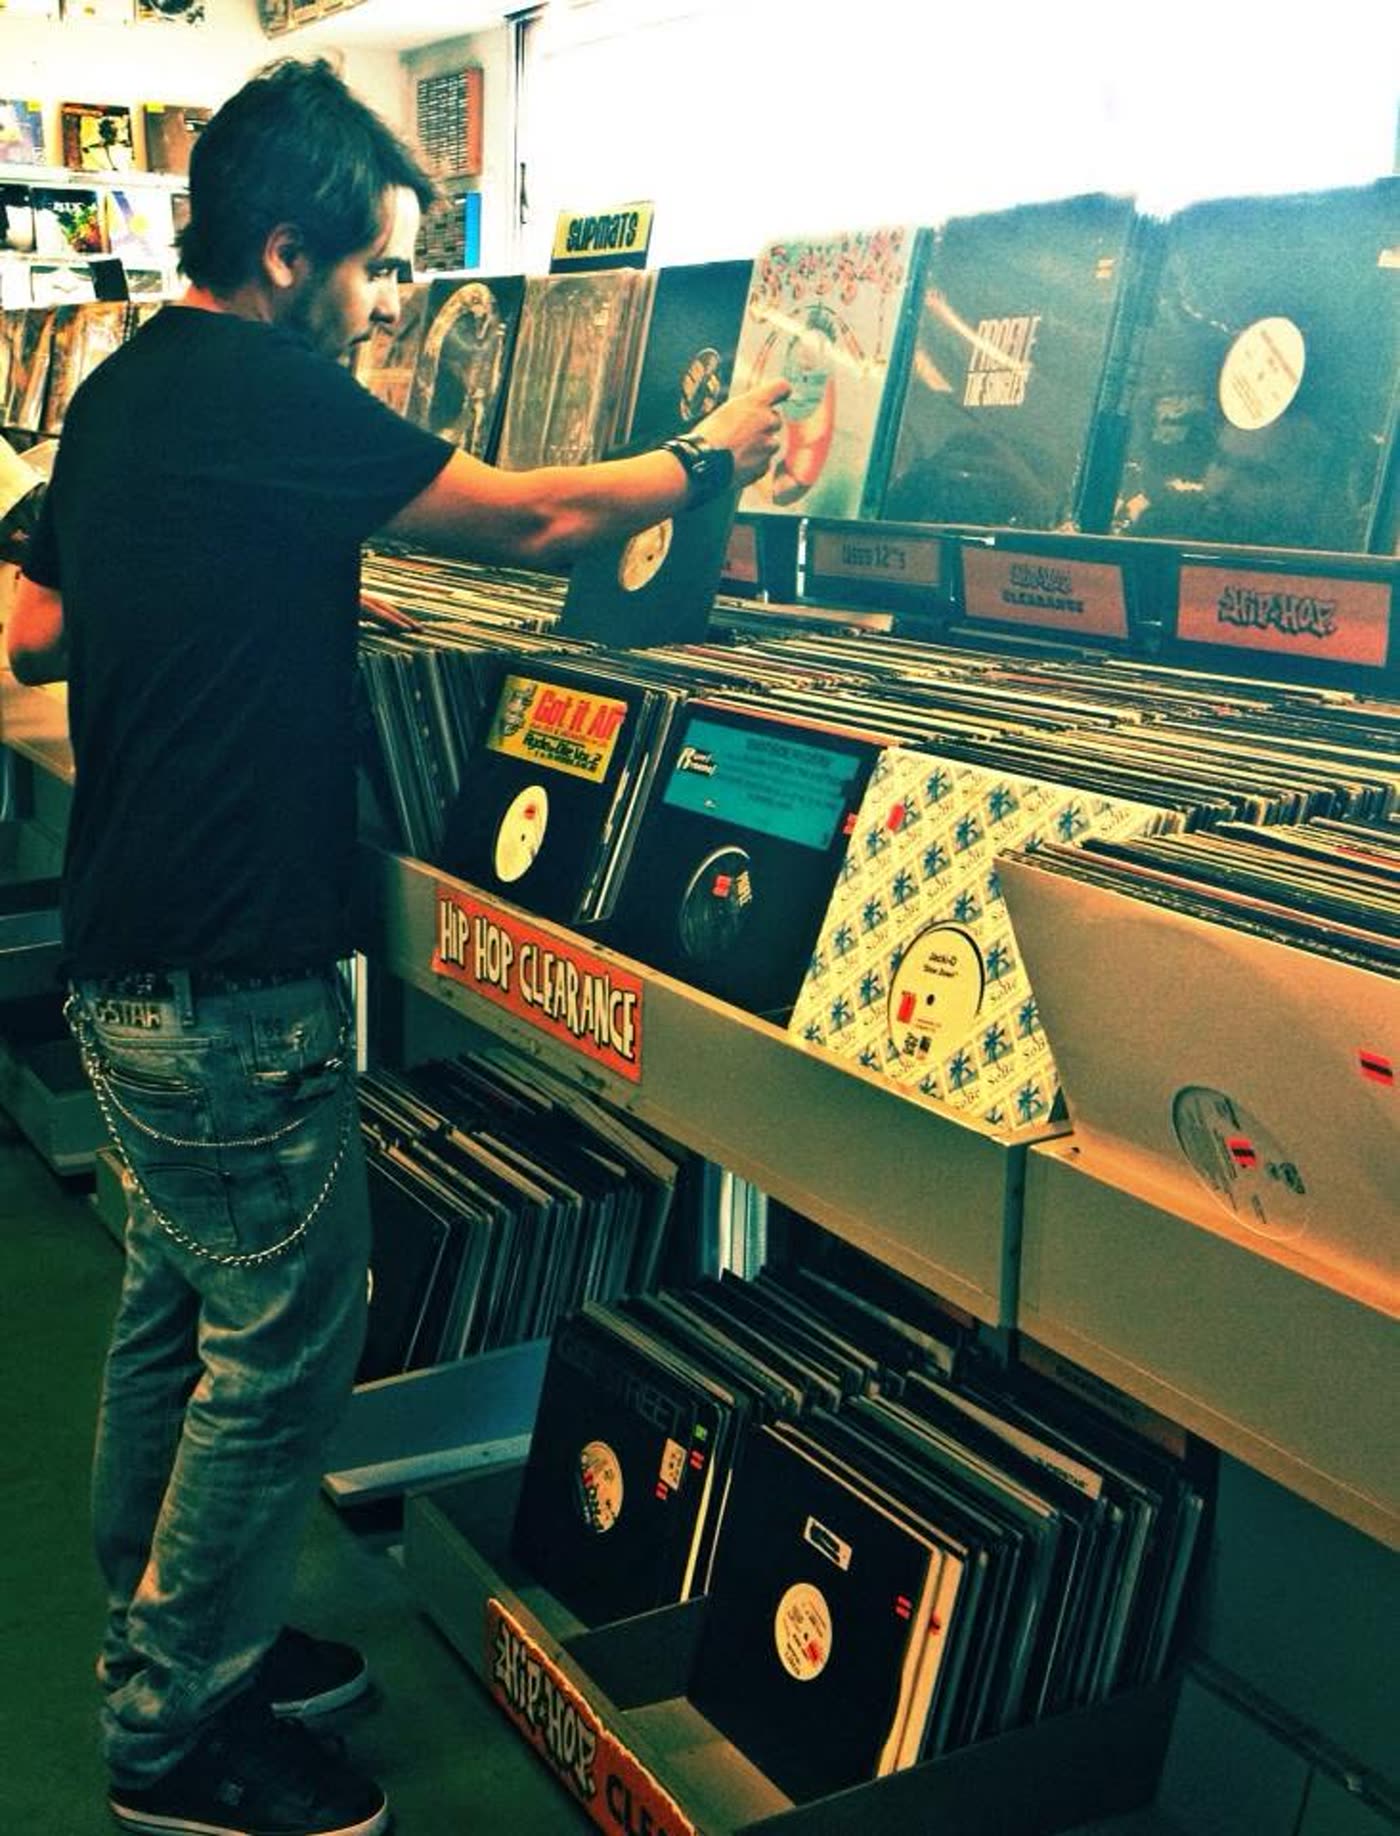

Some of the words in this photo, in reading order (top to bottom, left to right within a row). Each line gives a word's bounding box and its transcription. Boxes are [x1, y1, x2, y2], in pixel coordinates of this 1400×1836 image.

[440, 899, 470, 970] HIP
[475, 914, 514, 993] HOP
[519, 944, 637, 1064] CLEARANCE
